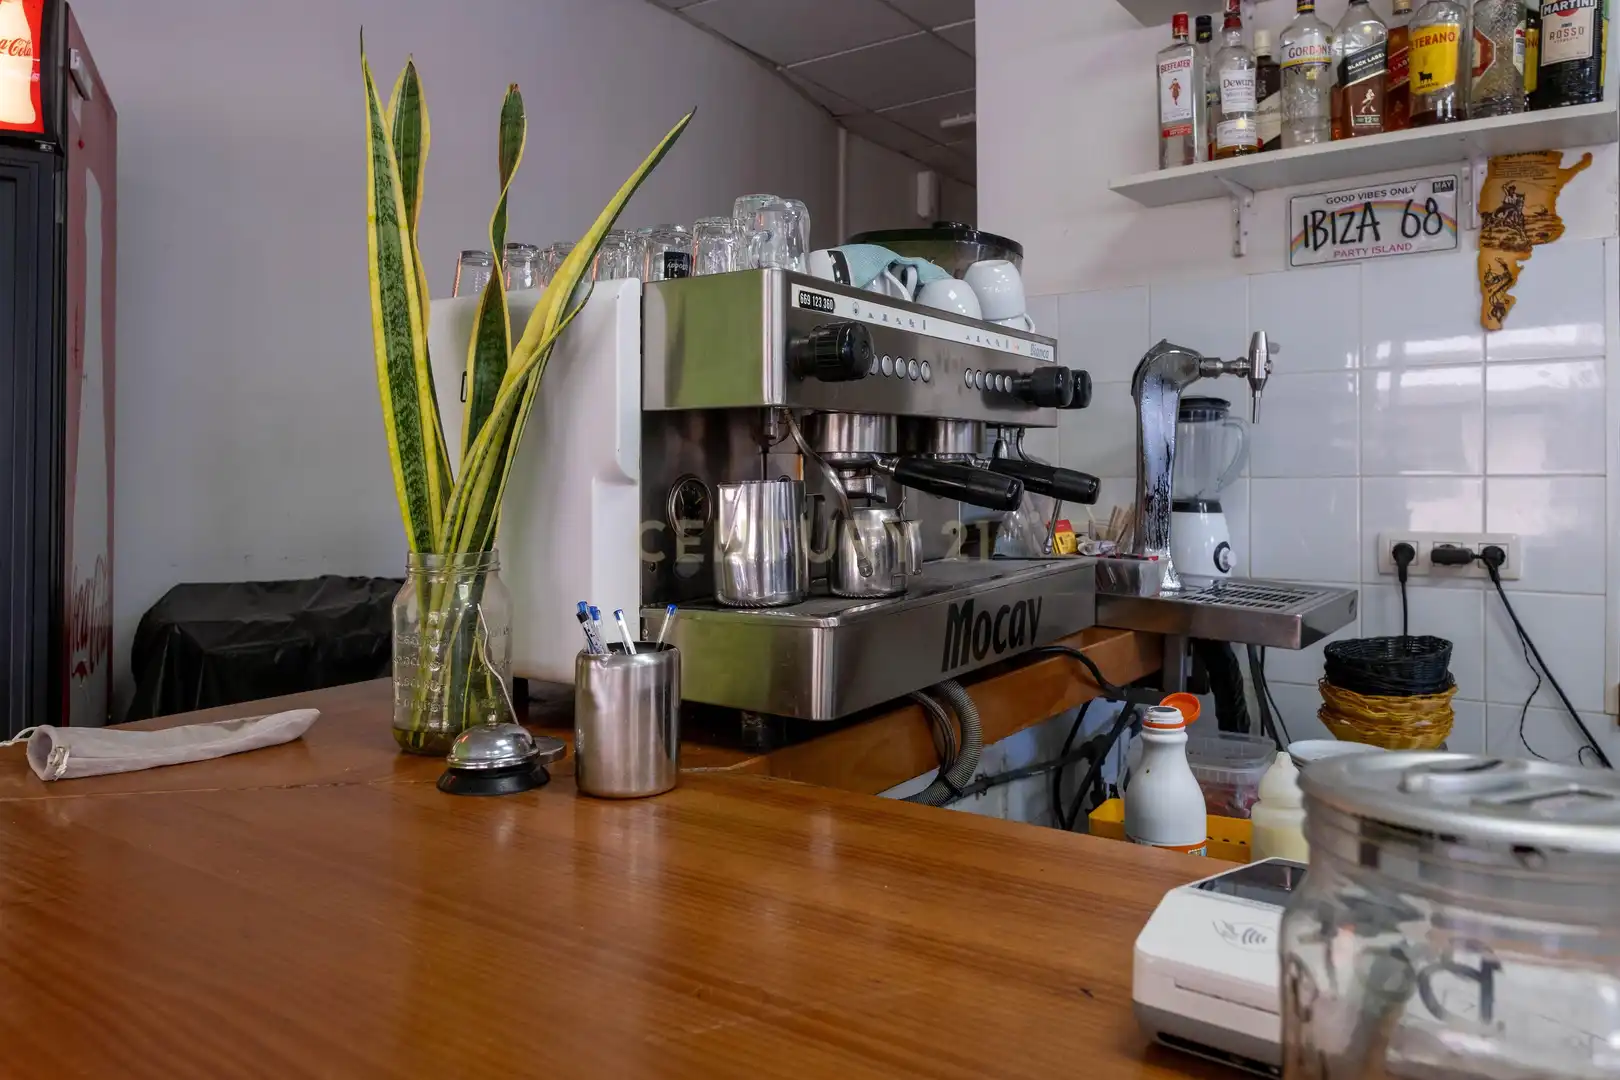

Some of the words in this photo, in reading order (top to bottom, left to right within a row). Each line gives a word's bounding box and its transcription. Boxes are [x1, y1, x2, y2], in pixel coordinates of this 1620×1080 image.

[1544, 0, 1594, 15] MARTINI
[1412, 31, 1456, 49] TERANO
[1549, 26, 1585, 41] ROSSO
[1160, 59, 1191, 74] BEEFEATER
[1347, 59, 1367, 70] BLACK
[1367, 52, 1385, 63] LABEL
[1433, 180, 1453, 191] MAY
[1326, 193, 1356, 205] GOOD
[1357, 189, 1388, 201] VIBES
[1390, 185, 1417, 198] ONLY
[1303, 201, 1381, 251] IBIZA
[1400, 197, 1443, 239] 68
[1333, 247, 1370, 259] PARTY
[1371, 241, 1413, 255] ISLAND
[800, 292, 811, 305] 669
[812, 295, 822, 308] 123
[941, 596, 1043, 673] Mocay
